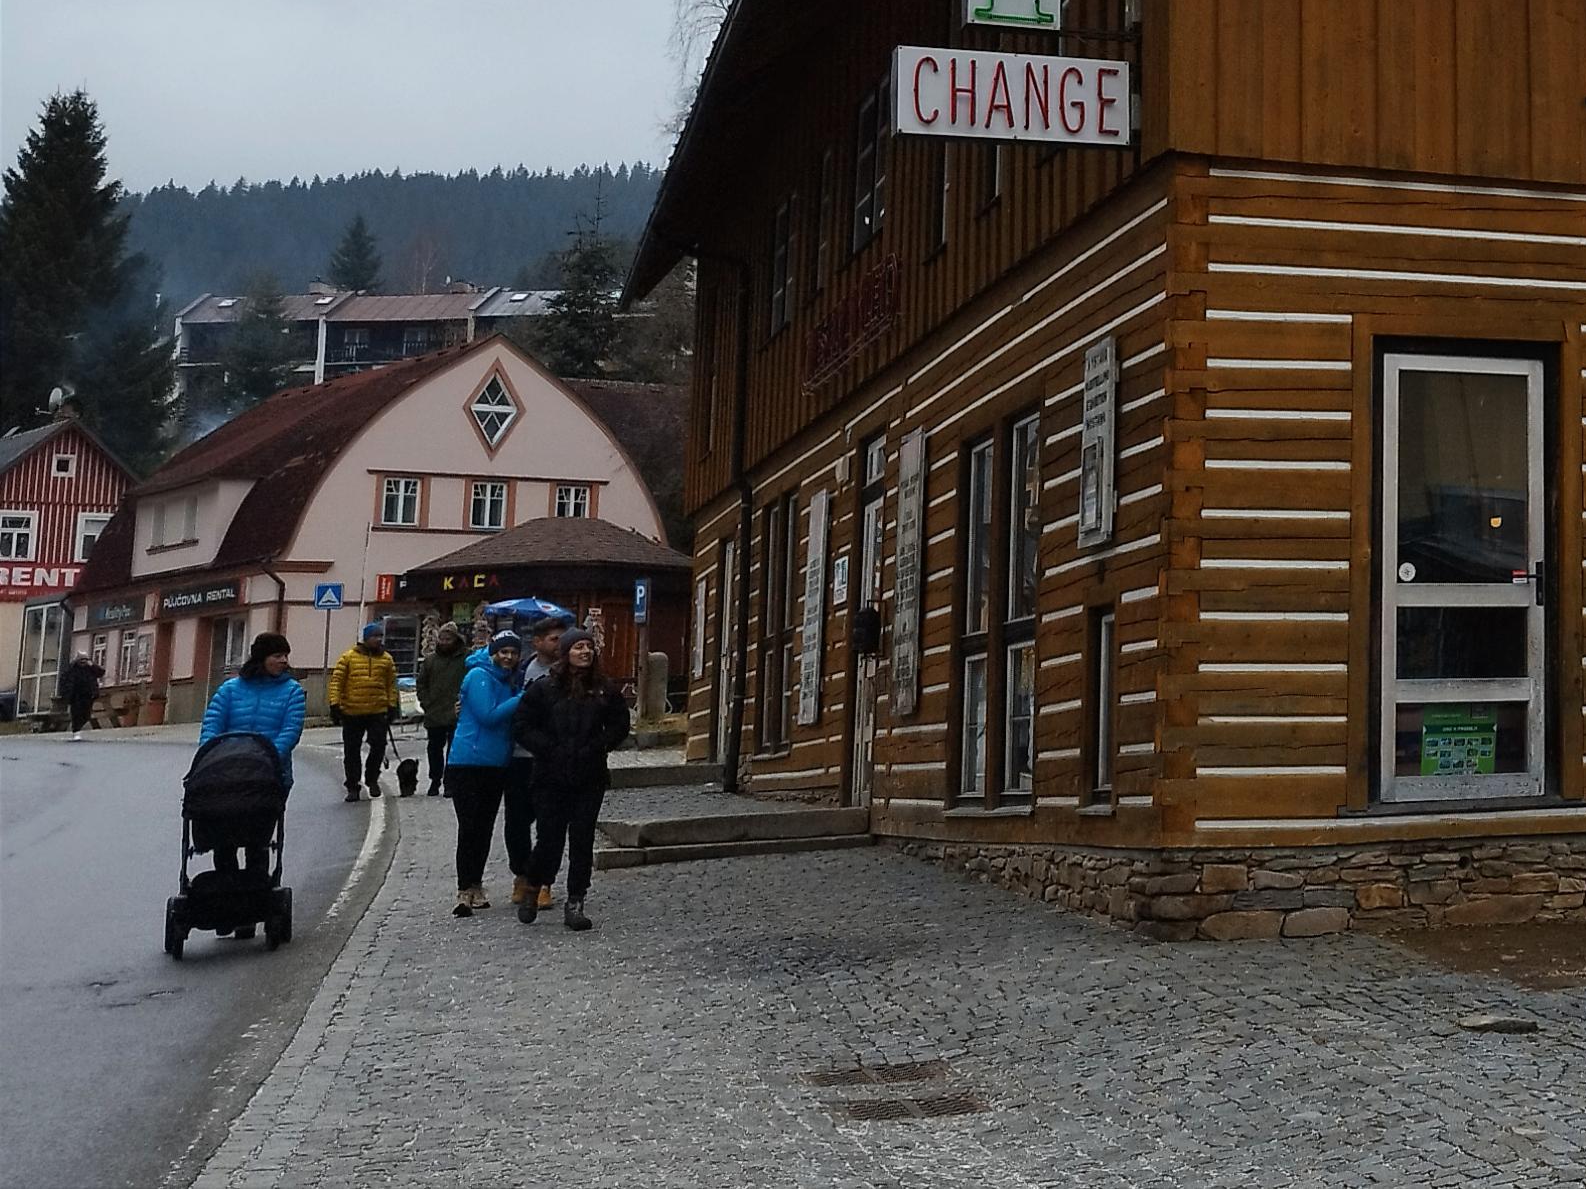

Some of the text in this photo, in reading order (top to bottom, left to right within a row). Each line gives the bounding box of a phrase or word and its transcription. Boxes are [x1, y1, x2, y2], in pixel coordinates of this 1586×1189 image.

[913, 56, 1120, 136] CHANGE
[206, 588, 236, 603] RENTAL
[636, 585, 645, 605] P
